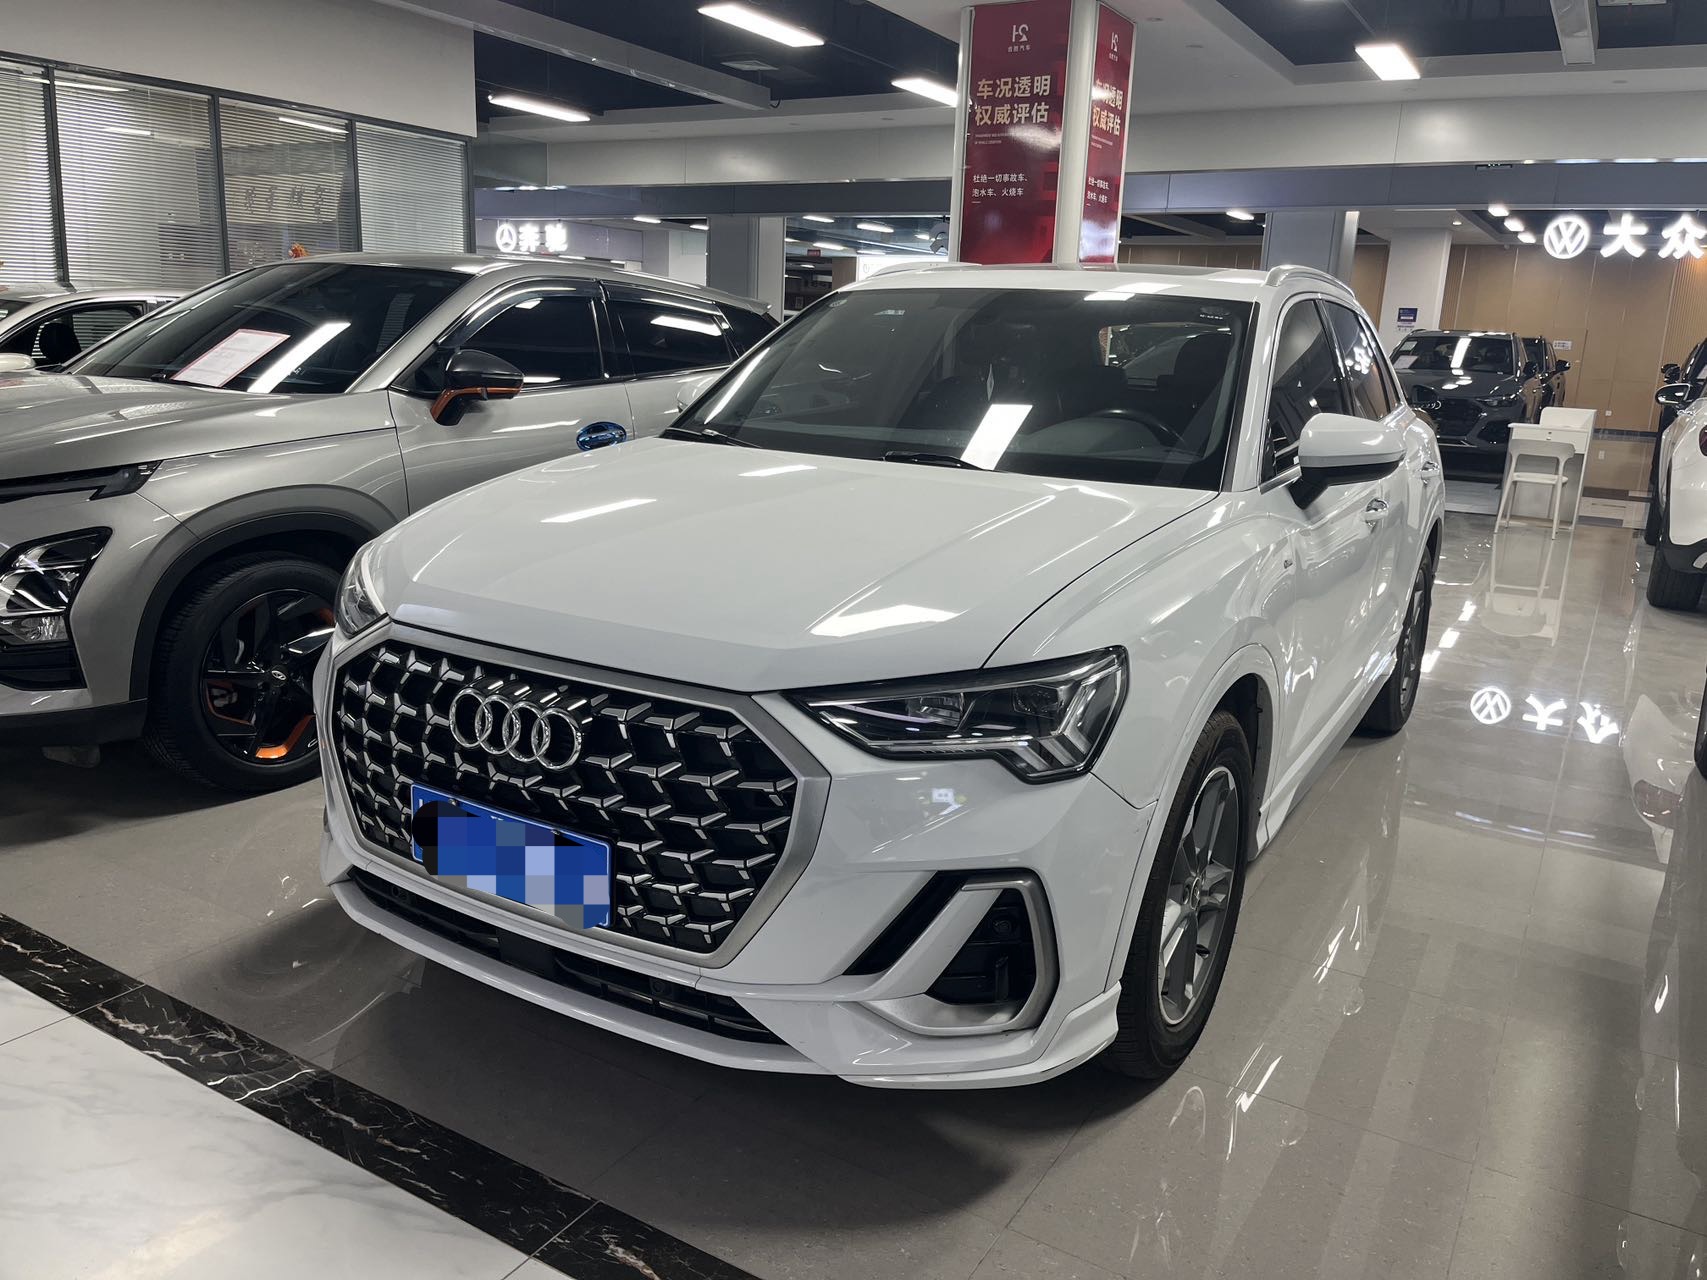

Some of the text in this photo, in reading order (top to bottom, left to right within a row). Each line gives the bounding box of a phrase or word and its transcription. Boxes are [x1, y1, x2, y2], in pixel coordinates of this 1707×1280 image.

[976, 75, 1051, 100] 车况透明
[974, 102, 1050, 126] 权威评估
[1092, 106, 1120, 136] 权威评估
[1600, 212, 1707, 260] 大众
